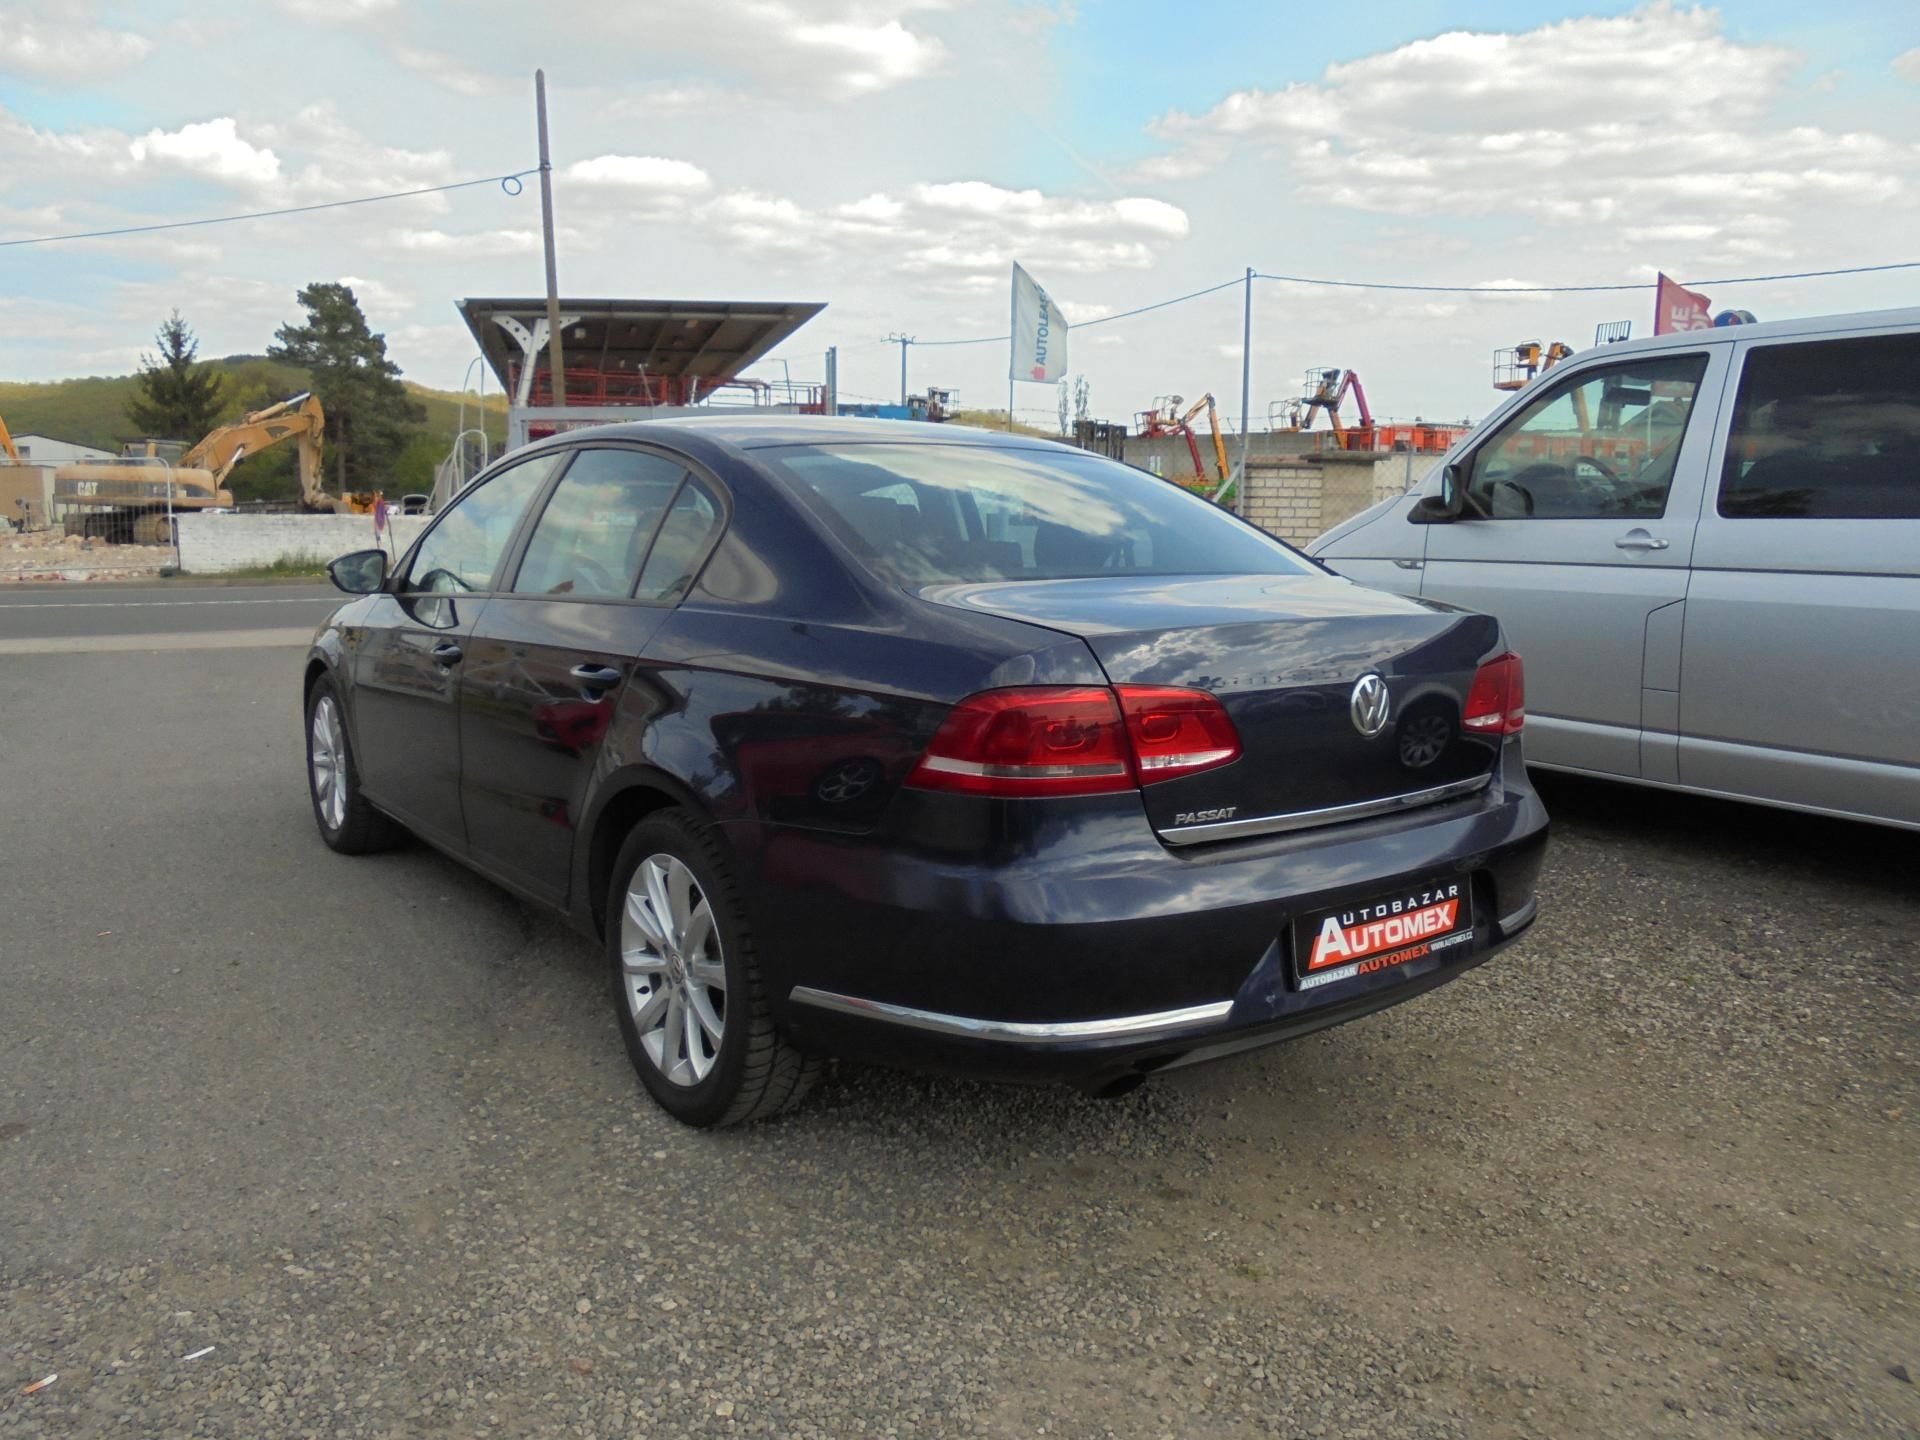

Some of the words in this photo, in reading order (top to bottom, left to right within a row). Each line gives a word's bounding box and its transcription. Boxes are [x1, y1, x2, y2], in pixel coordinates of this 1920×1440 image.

[77, 481, 99, 497] CAT
[1174, 806, 1237, 825] PASSAT
[1314, 903, 1452, 963] AUTOMEX
[1300, 966, 1358, 991] AUTOBAZAR
[1359, 943, 1430, 975] AUTOMEX
